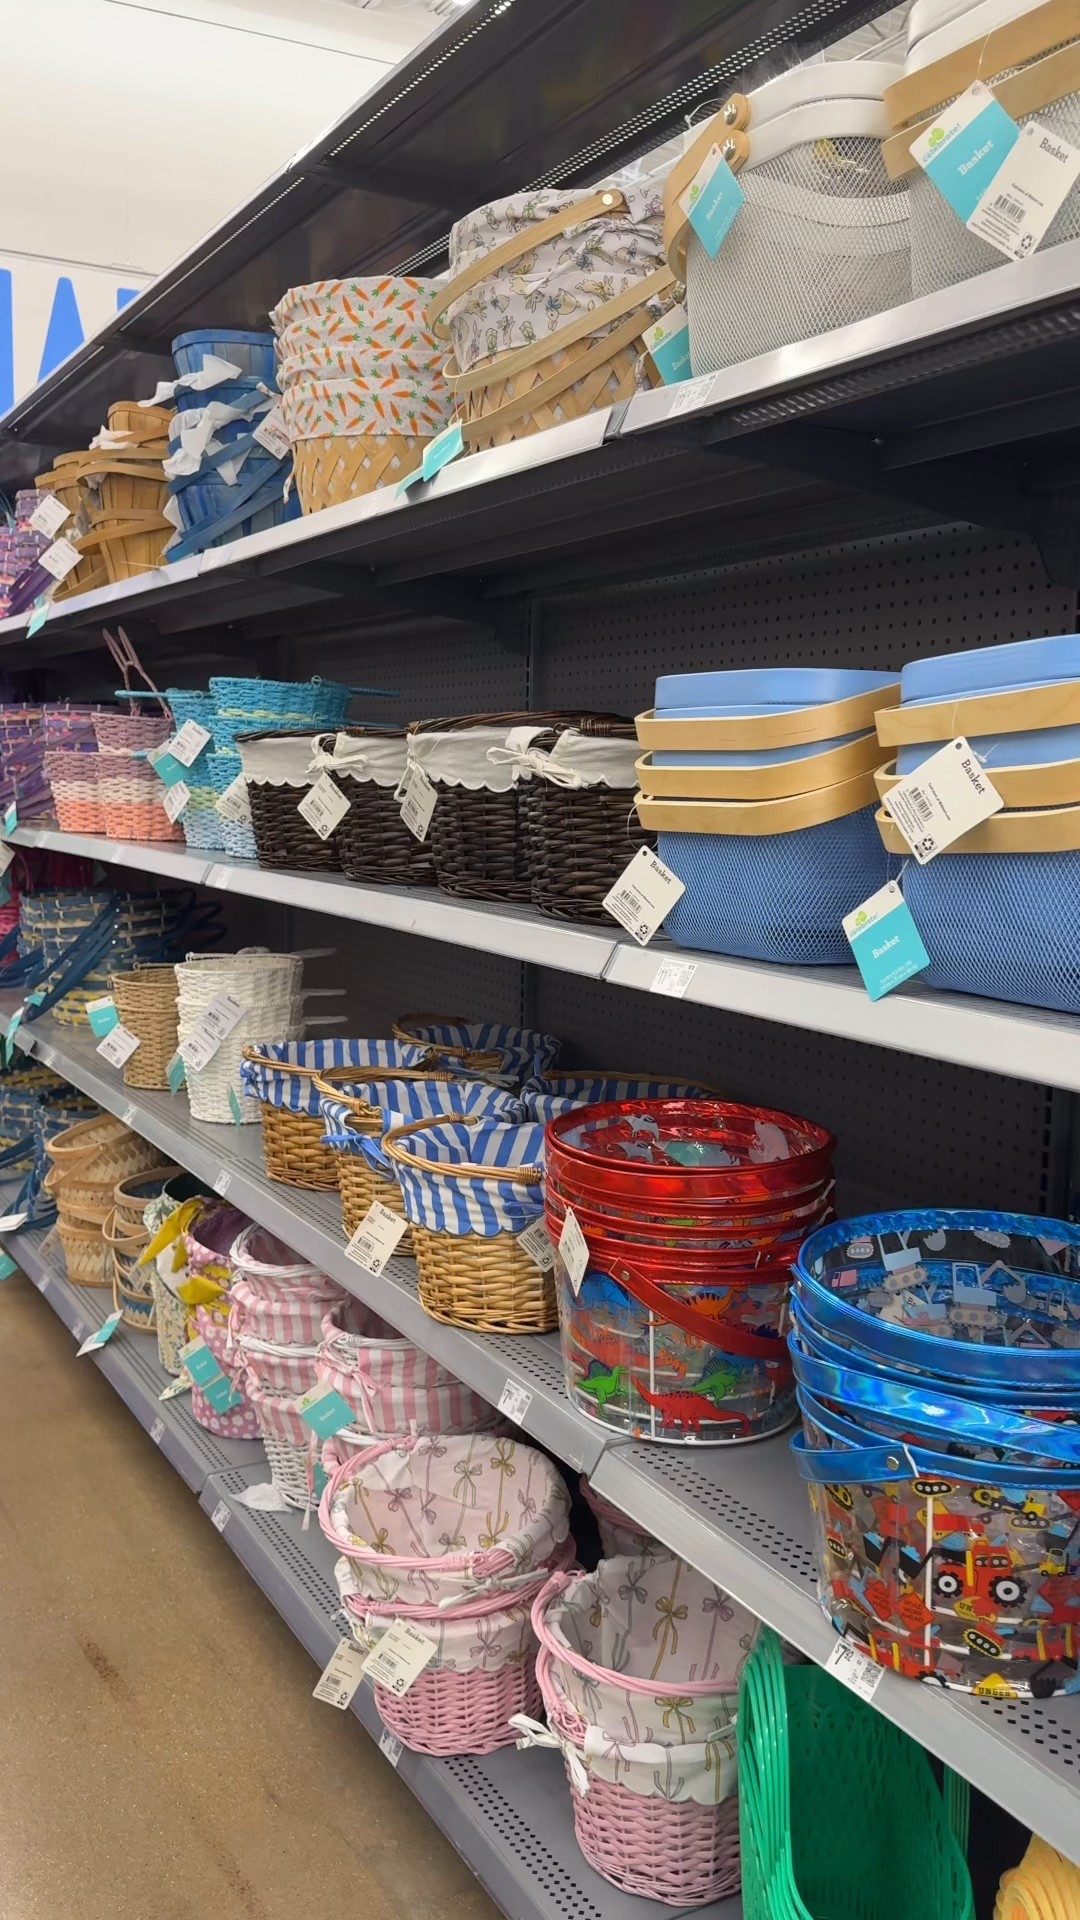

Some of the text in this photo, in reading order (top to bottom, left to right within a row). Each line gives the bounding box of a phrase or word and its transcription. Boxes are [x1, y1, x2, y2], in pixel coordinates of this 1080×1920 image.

[957, 139, 995, 176] Basket
[1039, 137, 1069, 164] Basket
[672, 351, 691, 371] Baske
[961, 758, 986, 795] Basket
[650, 860, 672, 885] Basket
[872, 935, 900, 959] Basket
[379, 1208, 397, 1224] Basket
[405, 1628, 426, 1645] Basket
